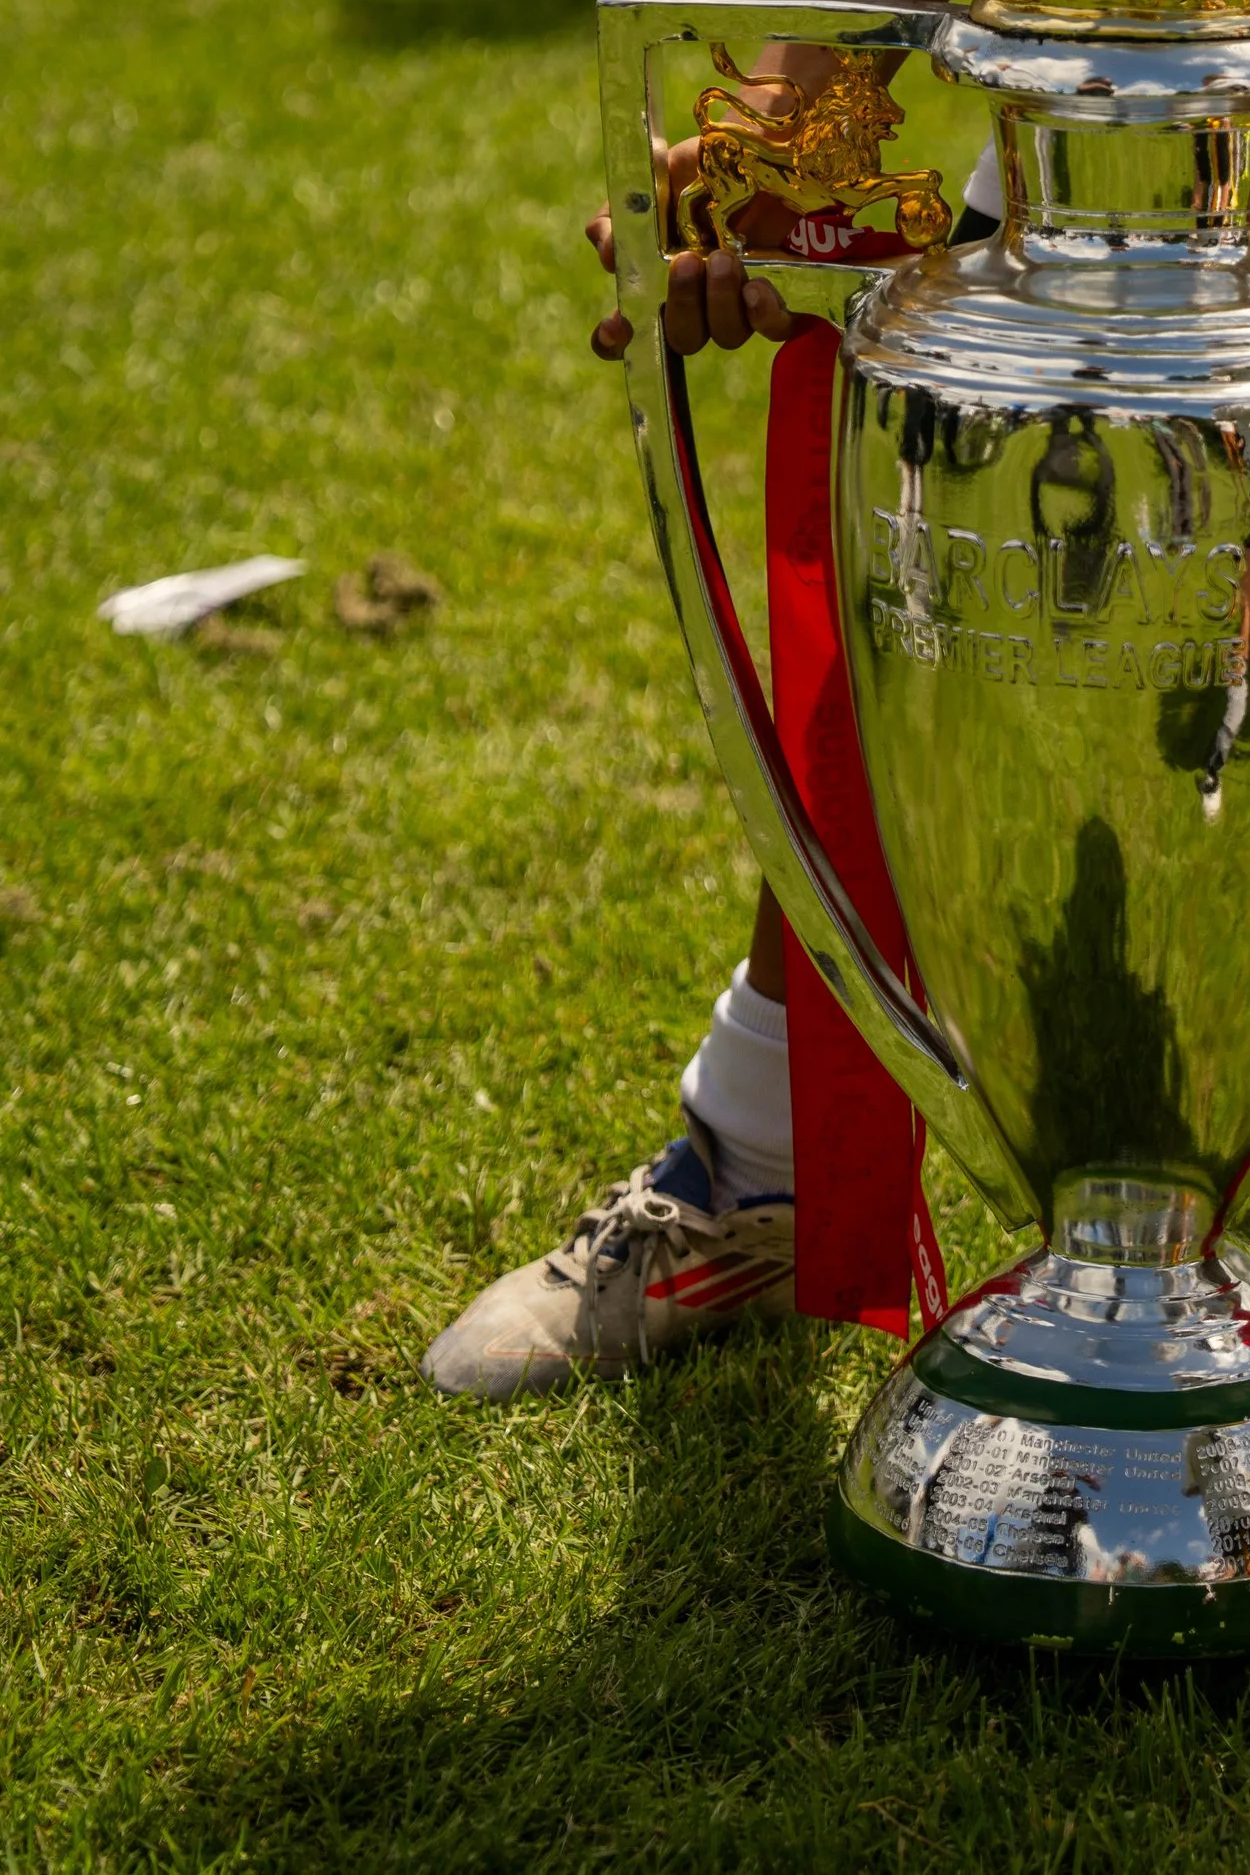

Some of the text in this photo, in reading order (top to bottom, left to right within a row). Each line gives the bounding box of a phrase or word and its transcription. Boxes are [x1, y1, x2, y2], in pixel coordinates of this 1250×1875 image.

[870, 506, 1247, 626] BARCLAYS
[870, 597, 1248, 691] PREMIER LEAGUE
[950, 1435, 1008, 1460] 2000-01
[937, 1469, 1000, 1495] 2002-03
[943, 1452, 1076, 1489] 2001-02 Arsenal
[931, 1486, 994, 1512] 2003-04
